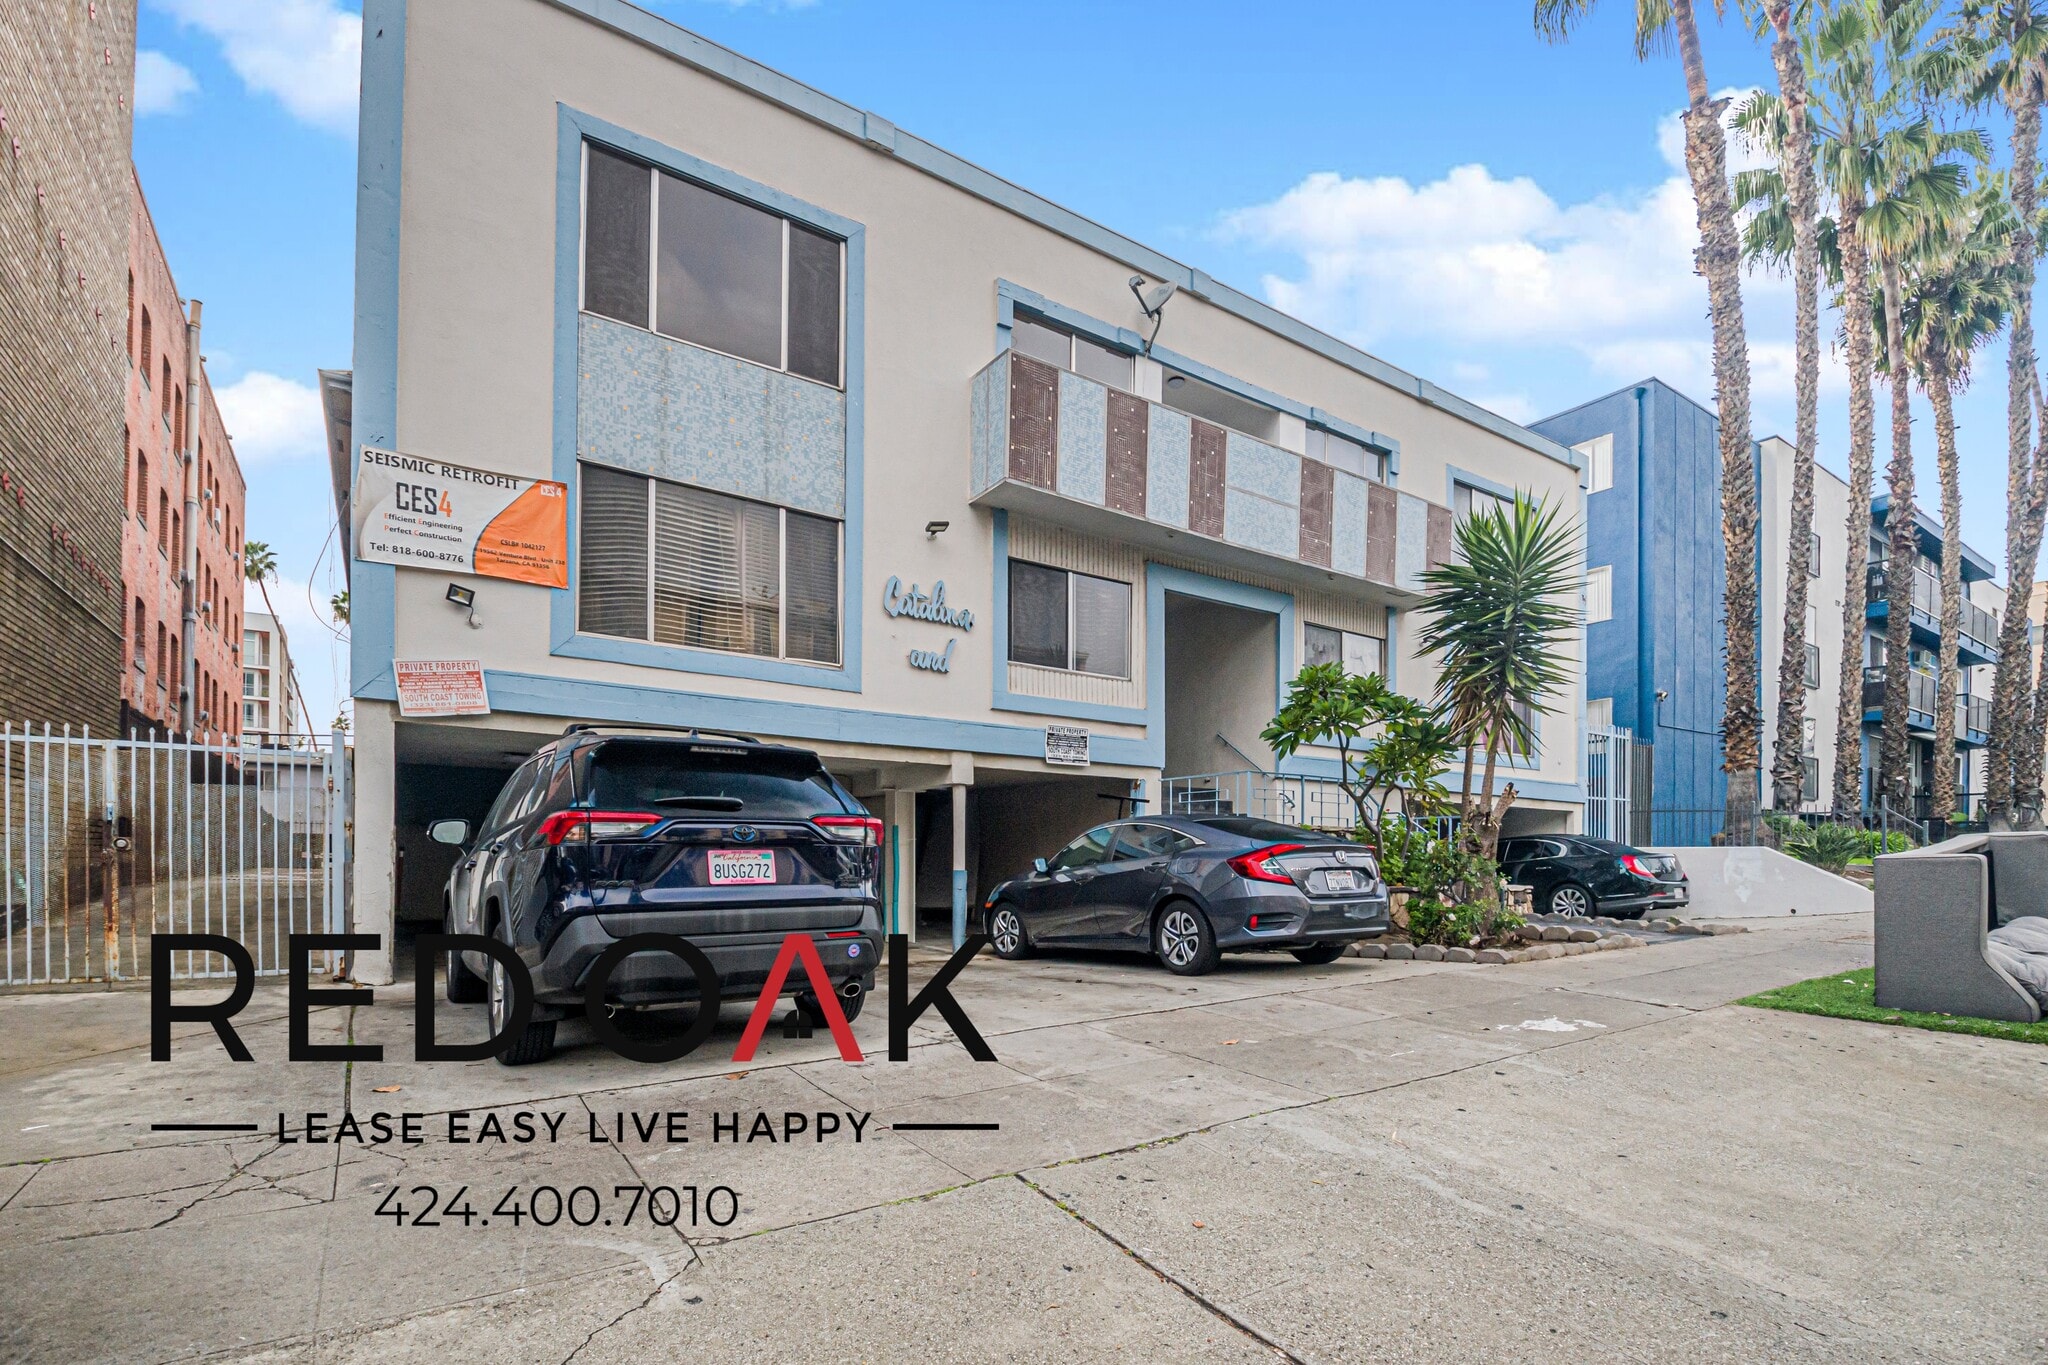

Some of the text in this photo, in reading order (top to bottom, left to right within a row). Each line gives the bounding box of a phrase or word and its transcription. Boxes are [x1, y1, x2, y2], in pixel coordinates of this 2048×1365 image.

[364, 450, 520, 490] SEISMIC RETROFIT
[384, 512, 463, 533] Efficient Engineering
[384, 525, 462, 543] Perfect Construction
[370, 542, 464, 563] Tel: 818-600-8776
[883, 575, 975, 632] Catalina
[400, 662, 477, 672] PRIVATE PROPERTY
[404, 692, 482, 702] SOUTH COAST TOWING
[714, 863, 771, 879] 8USG272
